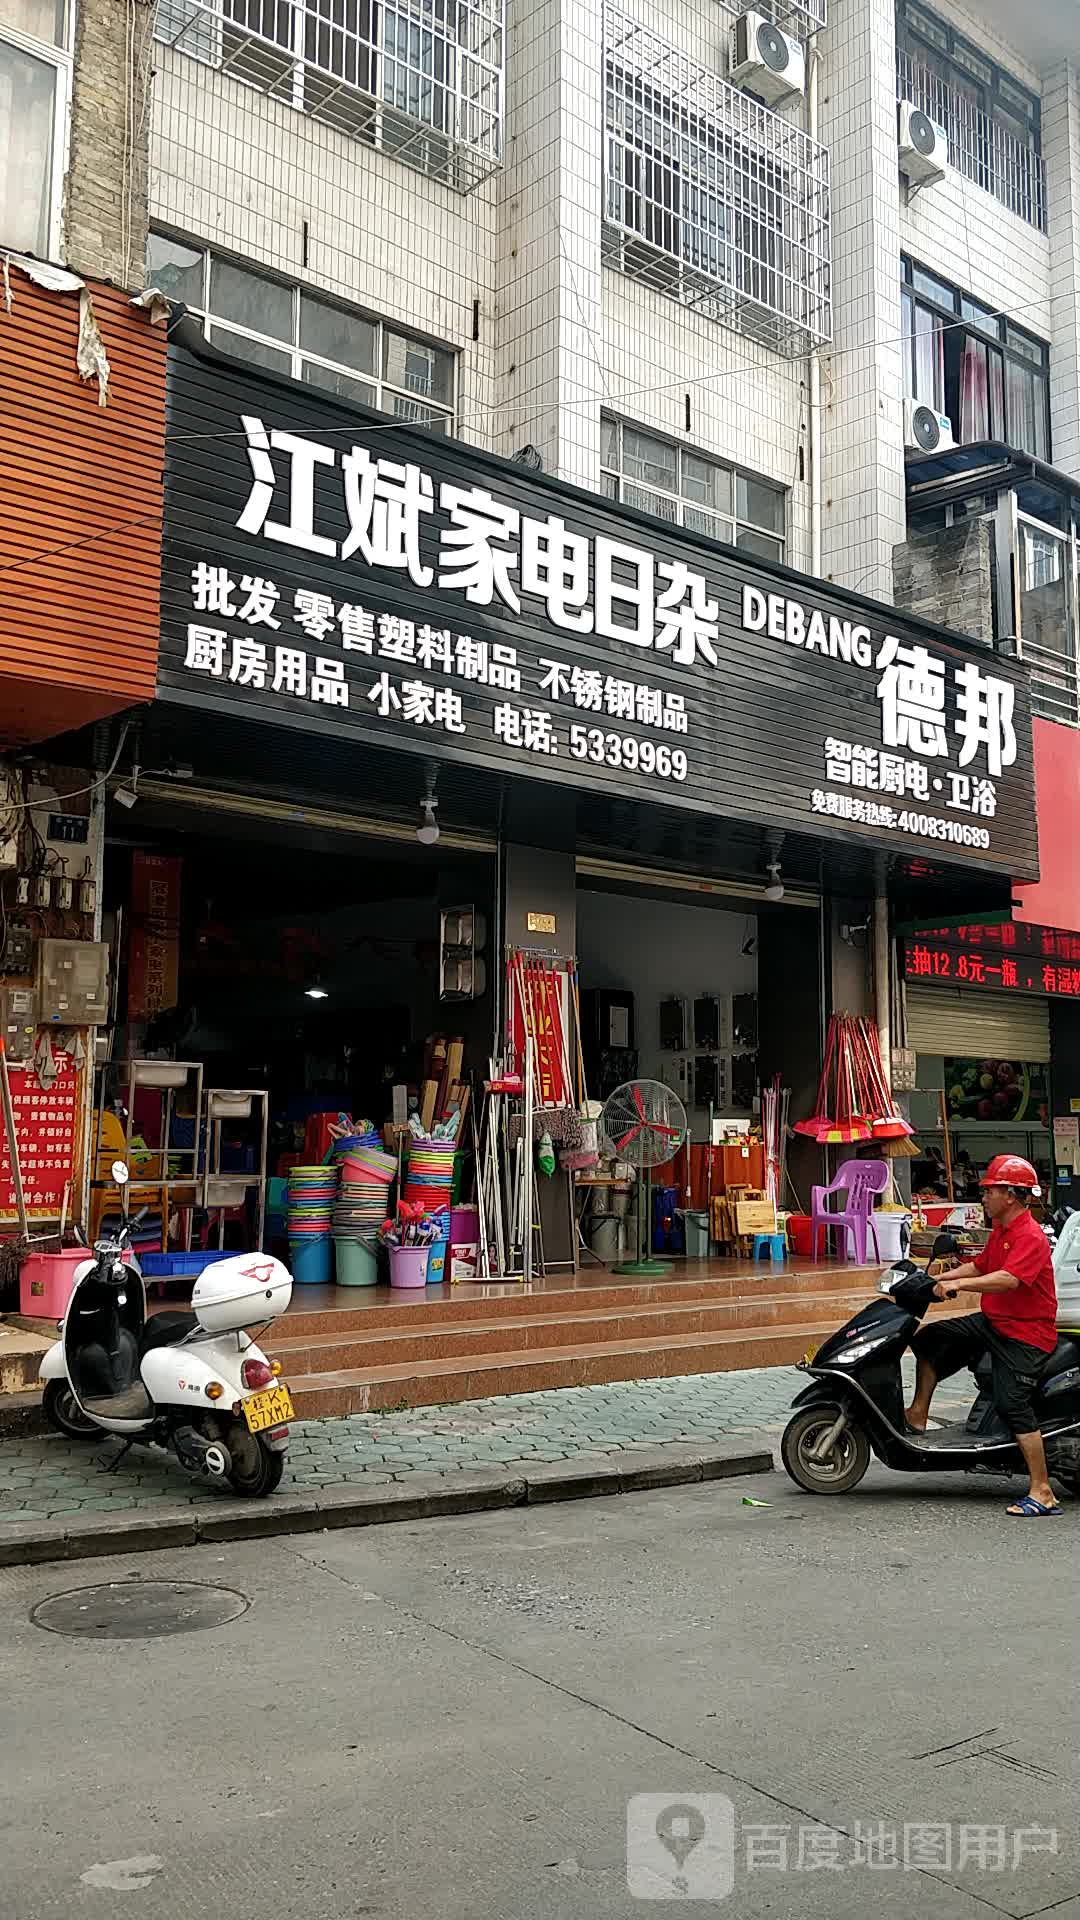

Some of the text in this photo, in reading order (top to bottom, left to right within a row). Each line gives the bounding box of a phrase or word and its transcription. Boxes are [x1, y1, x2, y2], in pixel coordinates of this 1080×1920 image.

[235, 415, 719, 666] 江斌家电日杂
[190, 562, 689, 733] 批发 零售塑料制品 不锈钢制品
[742, 585, 872, 667] DEBANG
[184, 623, 349, 707] 厨房用品
[368, 671, 466, 733] 小家电
[570, 725, 688, 781] 5339969
[876, 635, 1017, 778] 德邦
[249, 1402, 293, 1430] 57XM2
